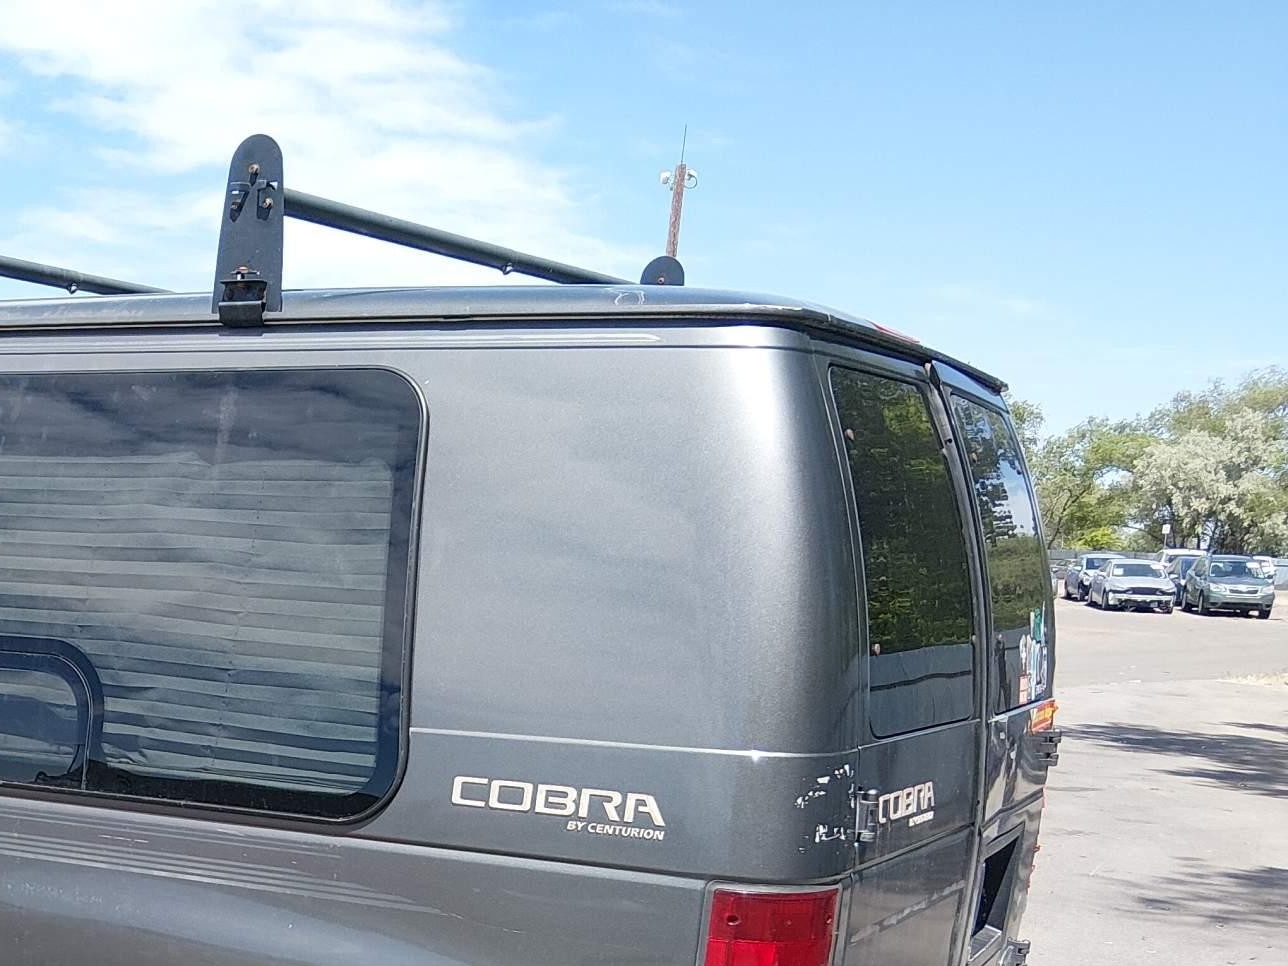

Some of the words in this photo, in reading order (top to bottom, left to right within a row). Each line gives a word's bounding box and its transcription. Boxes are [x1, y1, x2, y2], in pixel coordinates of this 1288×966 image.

[452, 776, 666, 827] COBRA
[878, 781, 935, 824] COBRA
[567, 820, 586, 832] BY
[587, 822, 665, 841] CENTURION
